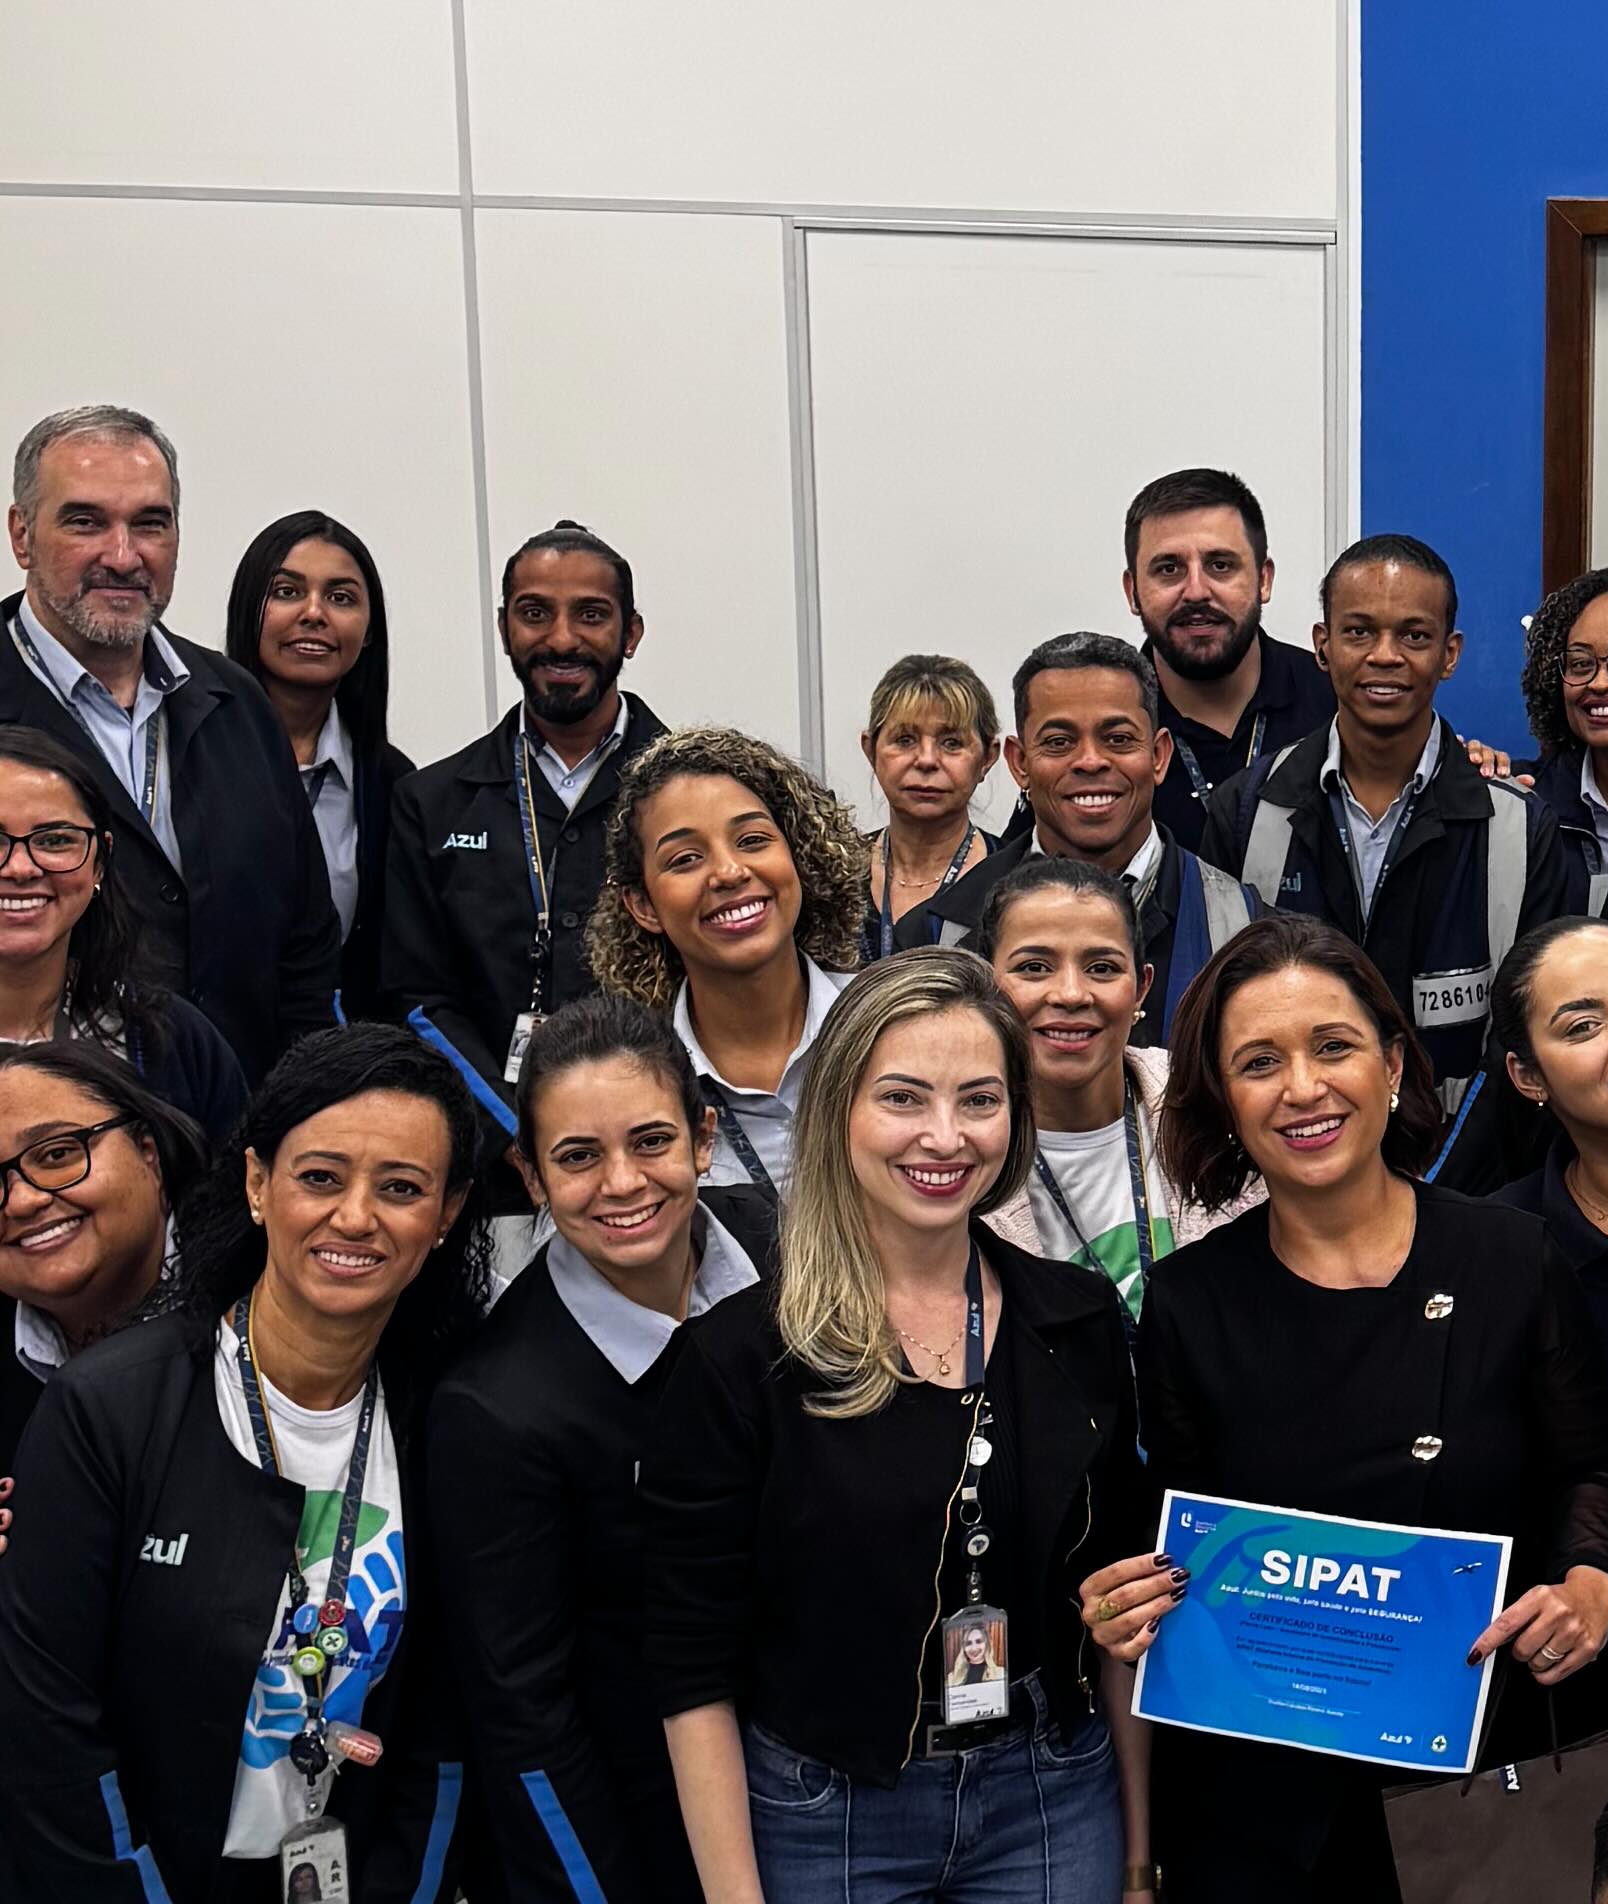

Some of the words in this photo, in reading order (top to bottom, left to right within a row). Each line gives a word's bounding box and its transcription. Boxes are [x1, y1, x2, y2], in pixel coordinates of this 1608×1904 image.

[442, 831, 488, 850] Azul
[1279, 871, 1302, 893] zul
[140, 1533, 190, 1566] zul
[1261, 1549, 1402, 1603] SIPAT
[1249, 1611, 1315, 1631] CERTIFICADO
[1316, 1622, 1330, 1633] DE
[1332, 1624, 1394, 1644] CONCLUSÃO
